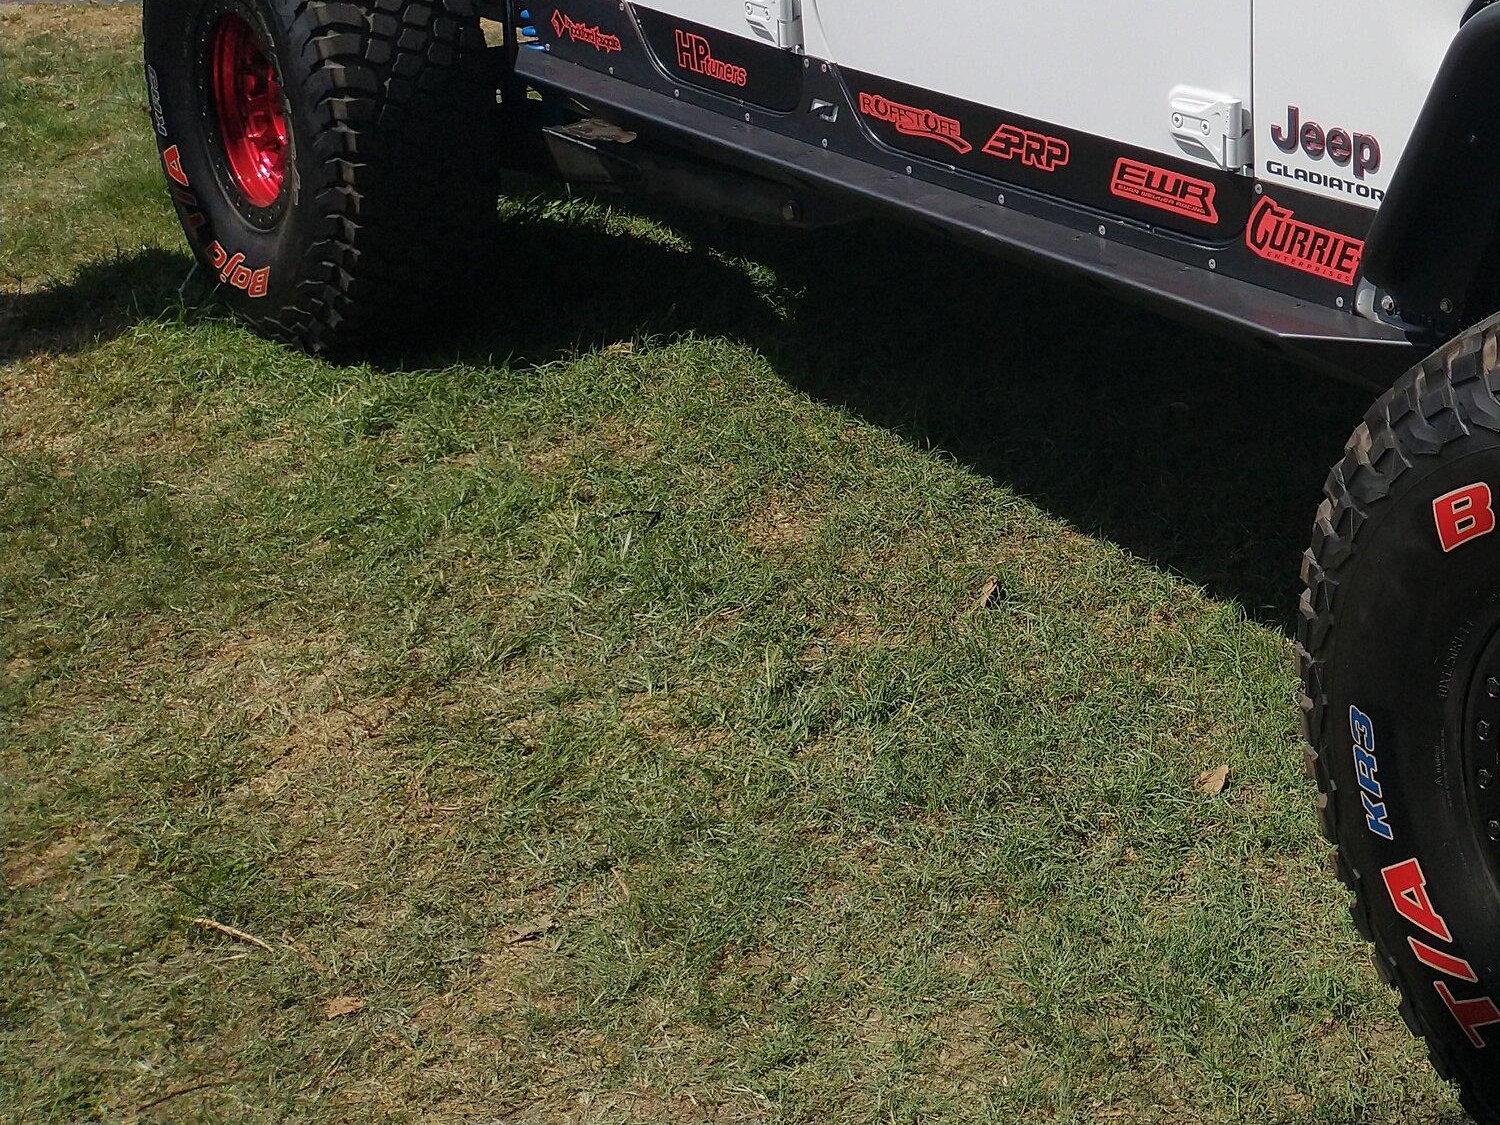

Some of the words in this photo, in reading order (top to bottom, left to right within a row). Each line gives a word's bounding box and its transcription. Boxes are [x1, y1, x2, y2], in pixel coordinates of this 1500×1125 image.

[985, 125, 1068, 170] PRP
[1270, 105, 1382, 181] Jeep
[1117, 162, 1212, 217] EWR
[1266, 160, 1386, 203] GLADIATOR
[1251, 200, 1363, 274] CURRIE
[206, 239, 272, 298] Baja
[1266, 250, 1352, 284] ENTERPRISES
[1348, 704, 1395, 842] KR3
